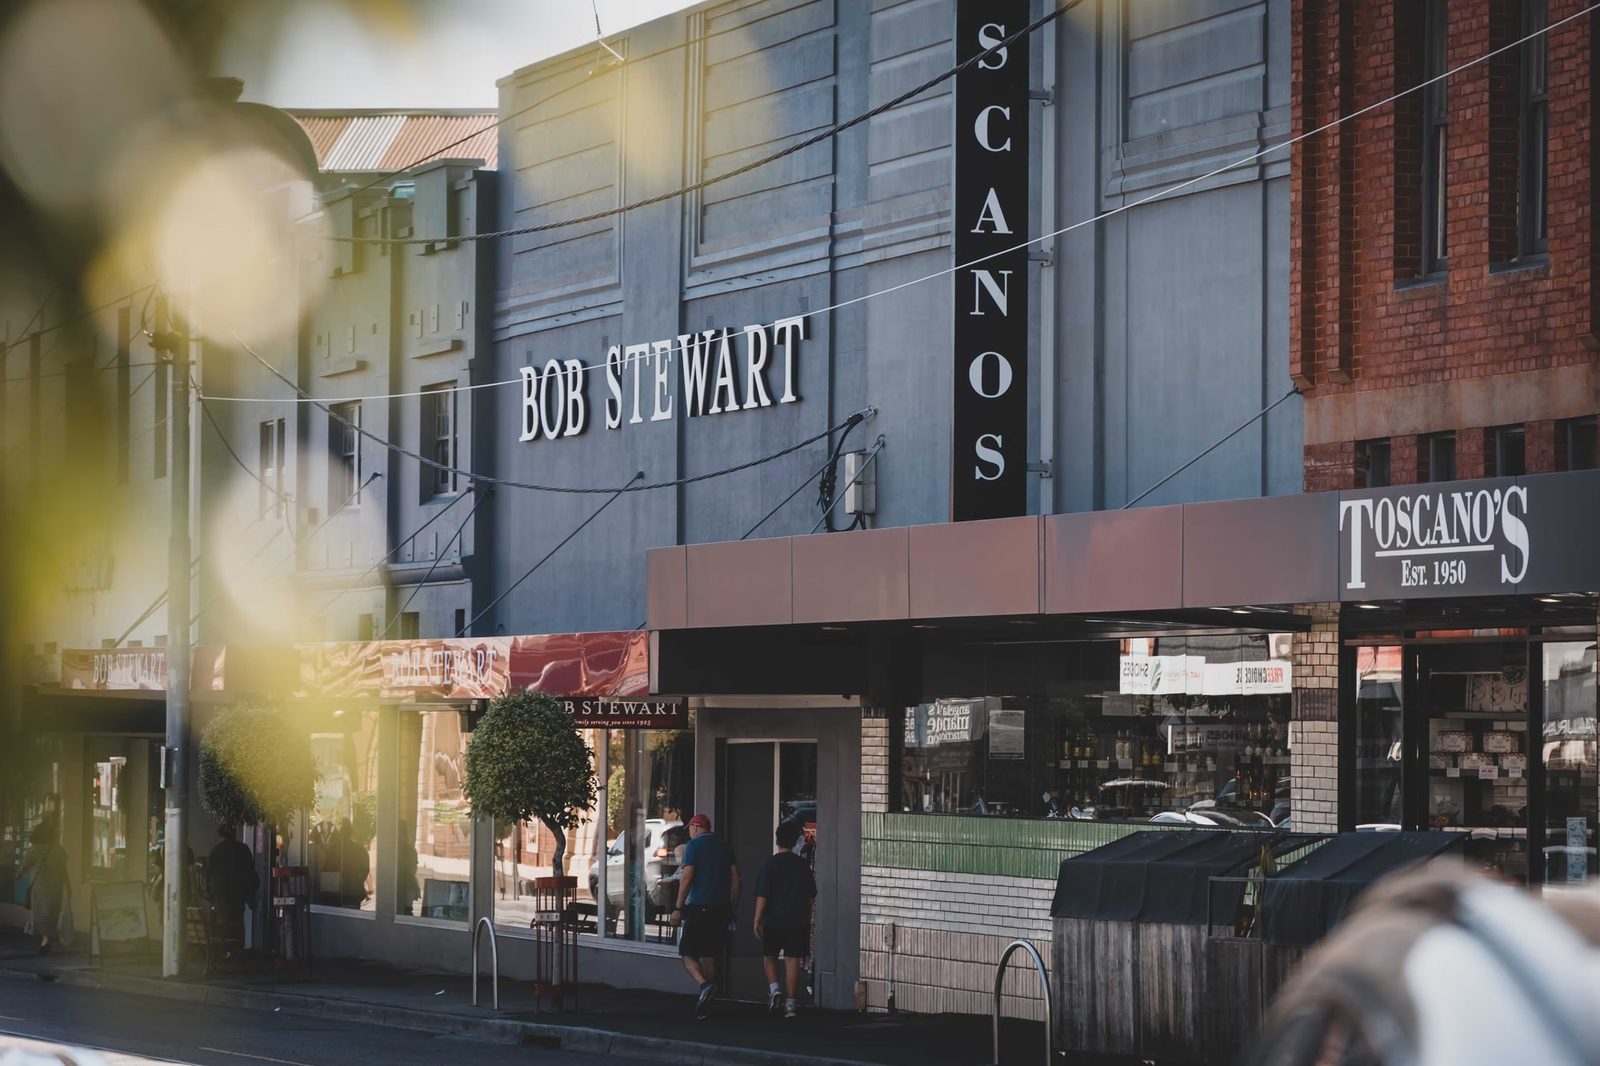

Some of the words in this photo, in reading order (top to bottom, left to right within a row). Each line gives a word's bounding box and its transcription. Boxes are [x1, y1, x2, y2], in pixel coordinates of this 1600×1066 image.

[519, 358, 586, 442] BOB
[605, 315, 806, 430] STEWART
[1340, 485, 1530, 589] TOSCANO'S
[1433, 560, 1466, 584] 1950
[93, 654, 113, 683] BOB
[116, 653, 164, 683] STEWART
[424, 646, 497, 686] STEWART
[582, 700, 680, 715] STEWART
